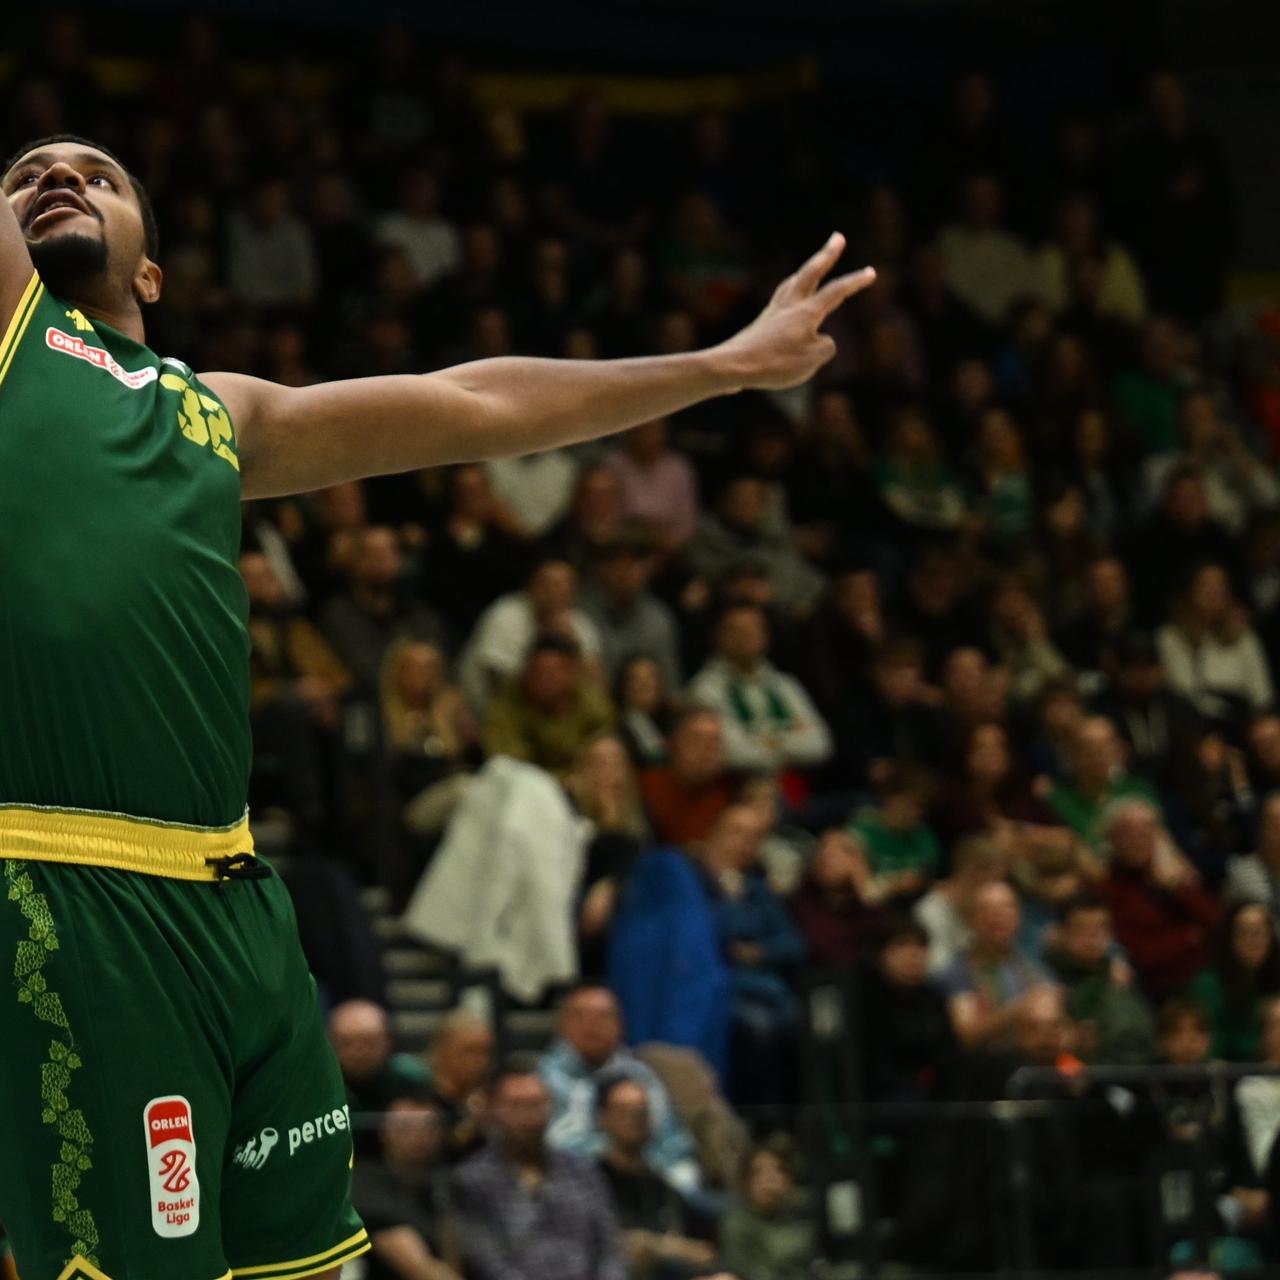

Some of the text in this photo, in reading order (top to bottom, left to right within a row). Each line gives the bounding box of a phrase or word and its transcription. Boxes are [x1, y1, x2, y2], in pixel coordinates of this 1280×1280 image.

[51, 333, 101, 364] ORLEN
[151, 1115, 188, 1131] ORLEN
[158, 1197, 195, 1213] Basket
[166, 1212, 190, 1226] Liga
